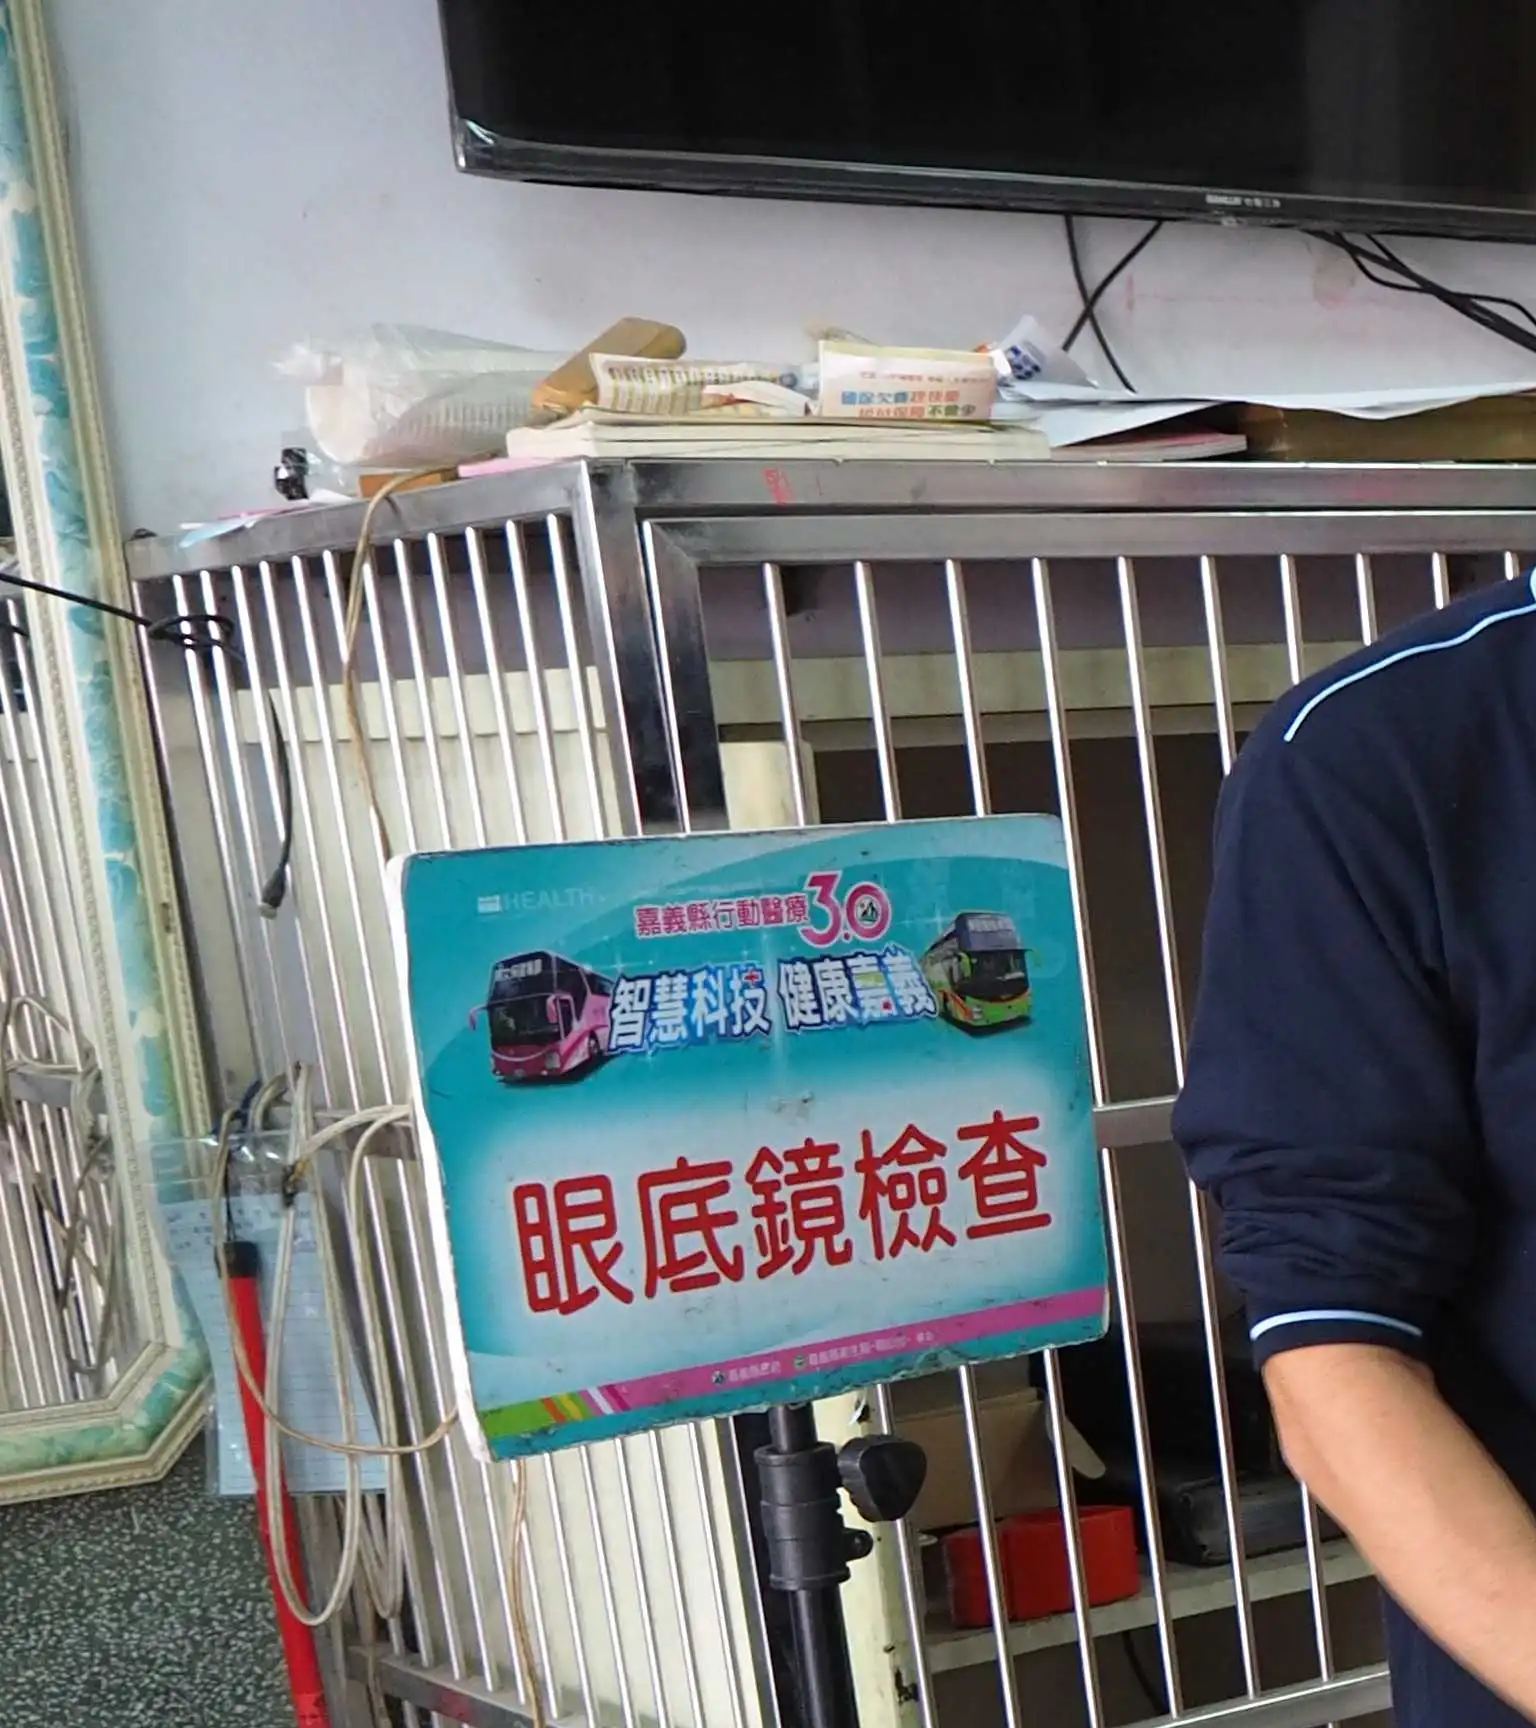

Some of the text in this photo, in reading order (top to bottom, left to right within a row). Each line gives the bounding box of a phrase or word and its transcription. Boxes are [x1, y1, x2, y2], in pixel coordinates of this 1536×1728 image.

[609, 948, 937, 1052] 智慧科技 健康嘉義
[511, 1109, 1052, 1316] 眼底鏡檢查
